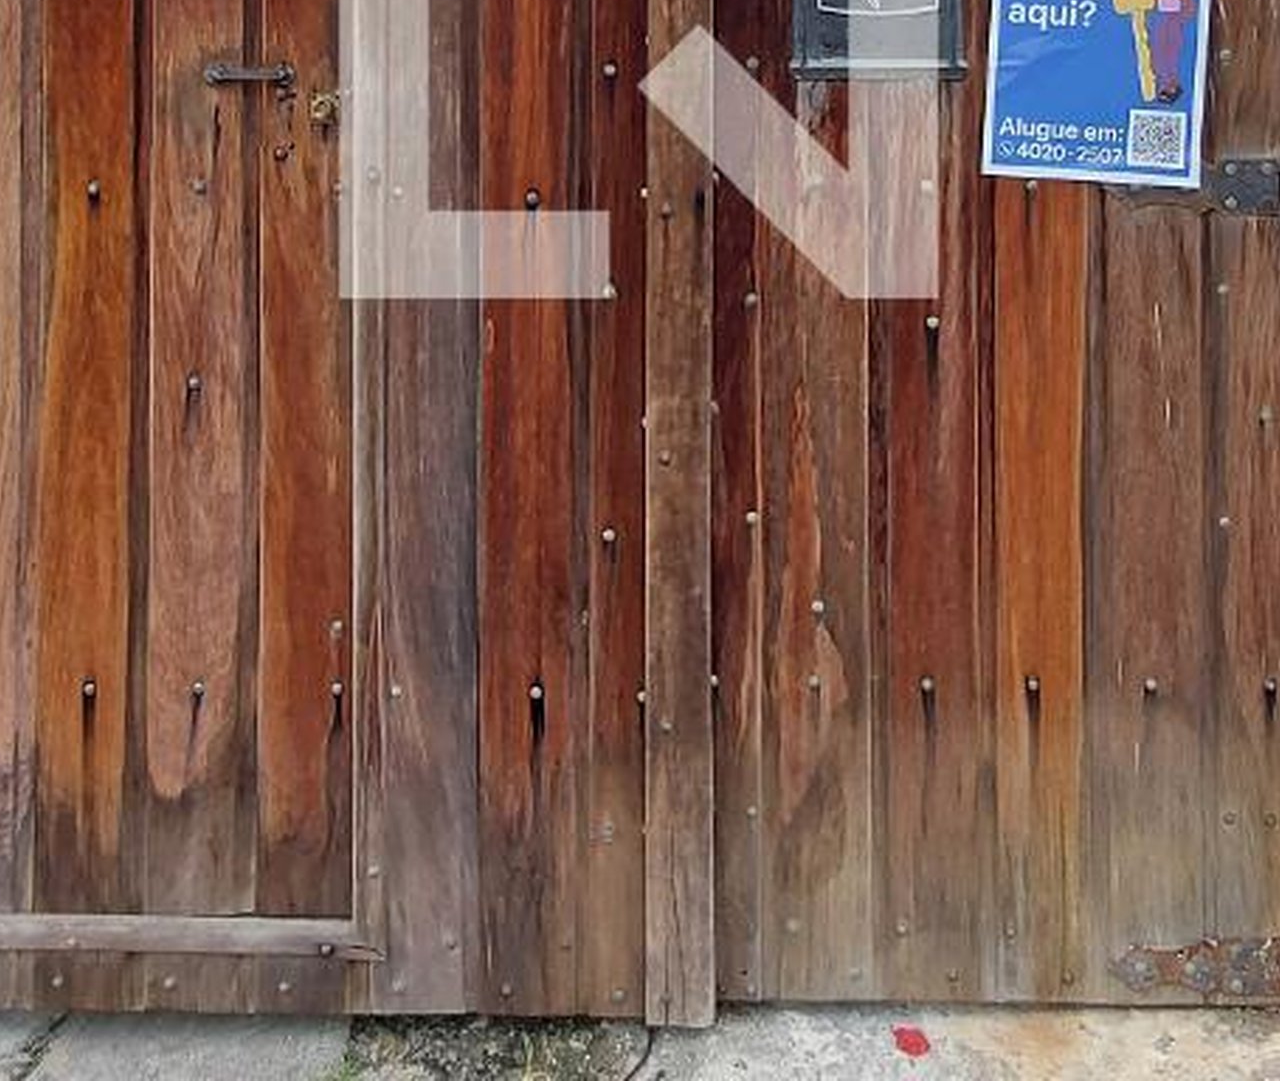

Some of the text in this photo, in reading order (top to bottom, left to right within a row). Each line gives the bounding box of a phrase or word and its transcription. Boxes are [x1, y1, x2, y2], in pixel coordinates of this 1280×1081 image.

[1008, 0, 1097, 31] aqui?
[999, 116, 1124, 142] Alugue em:
